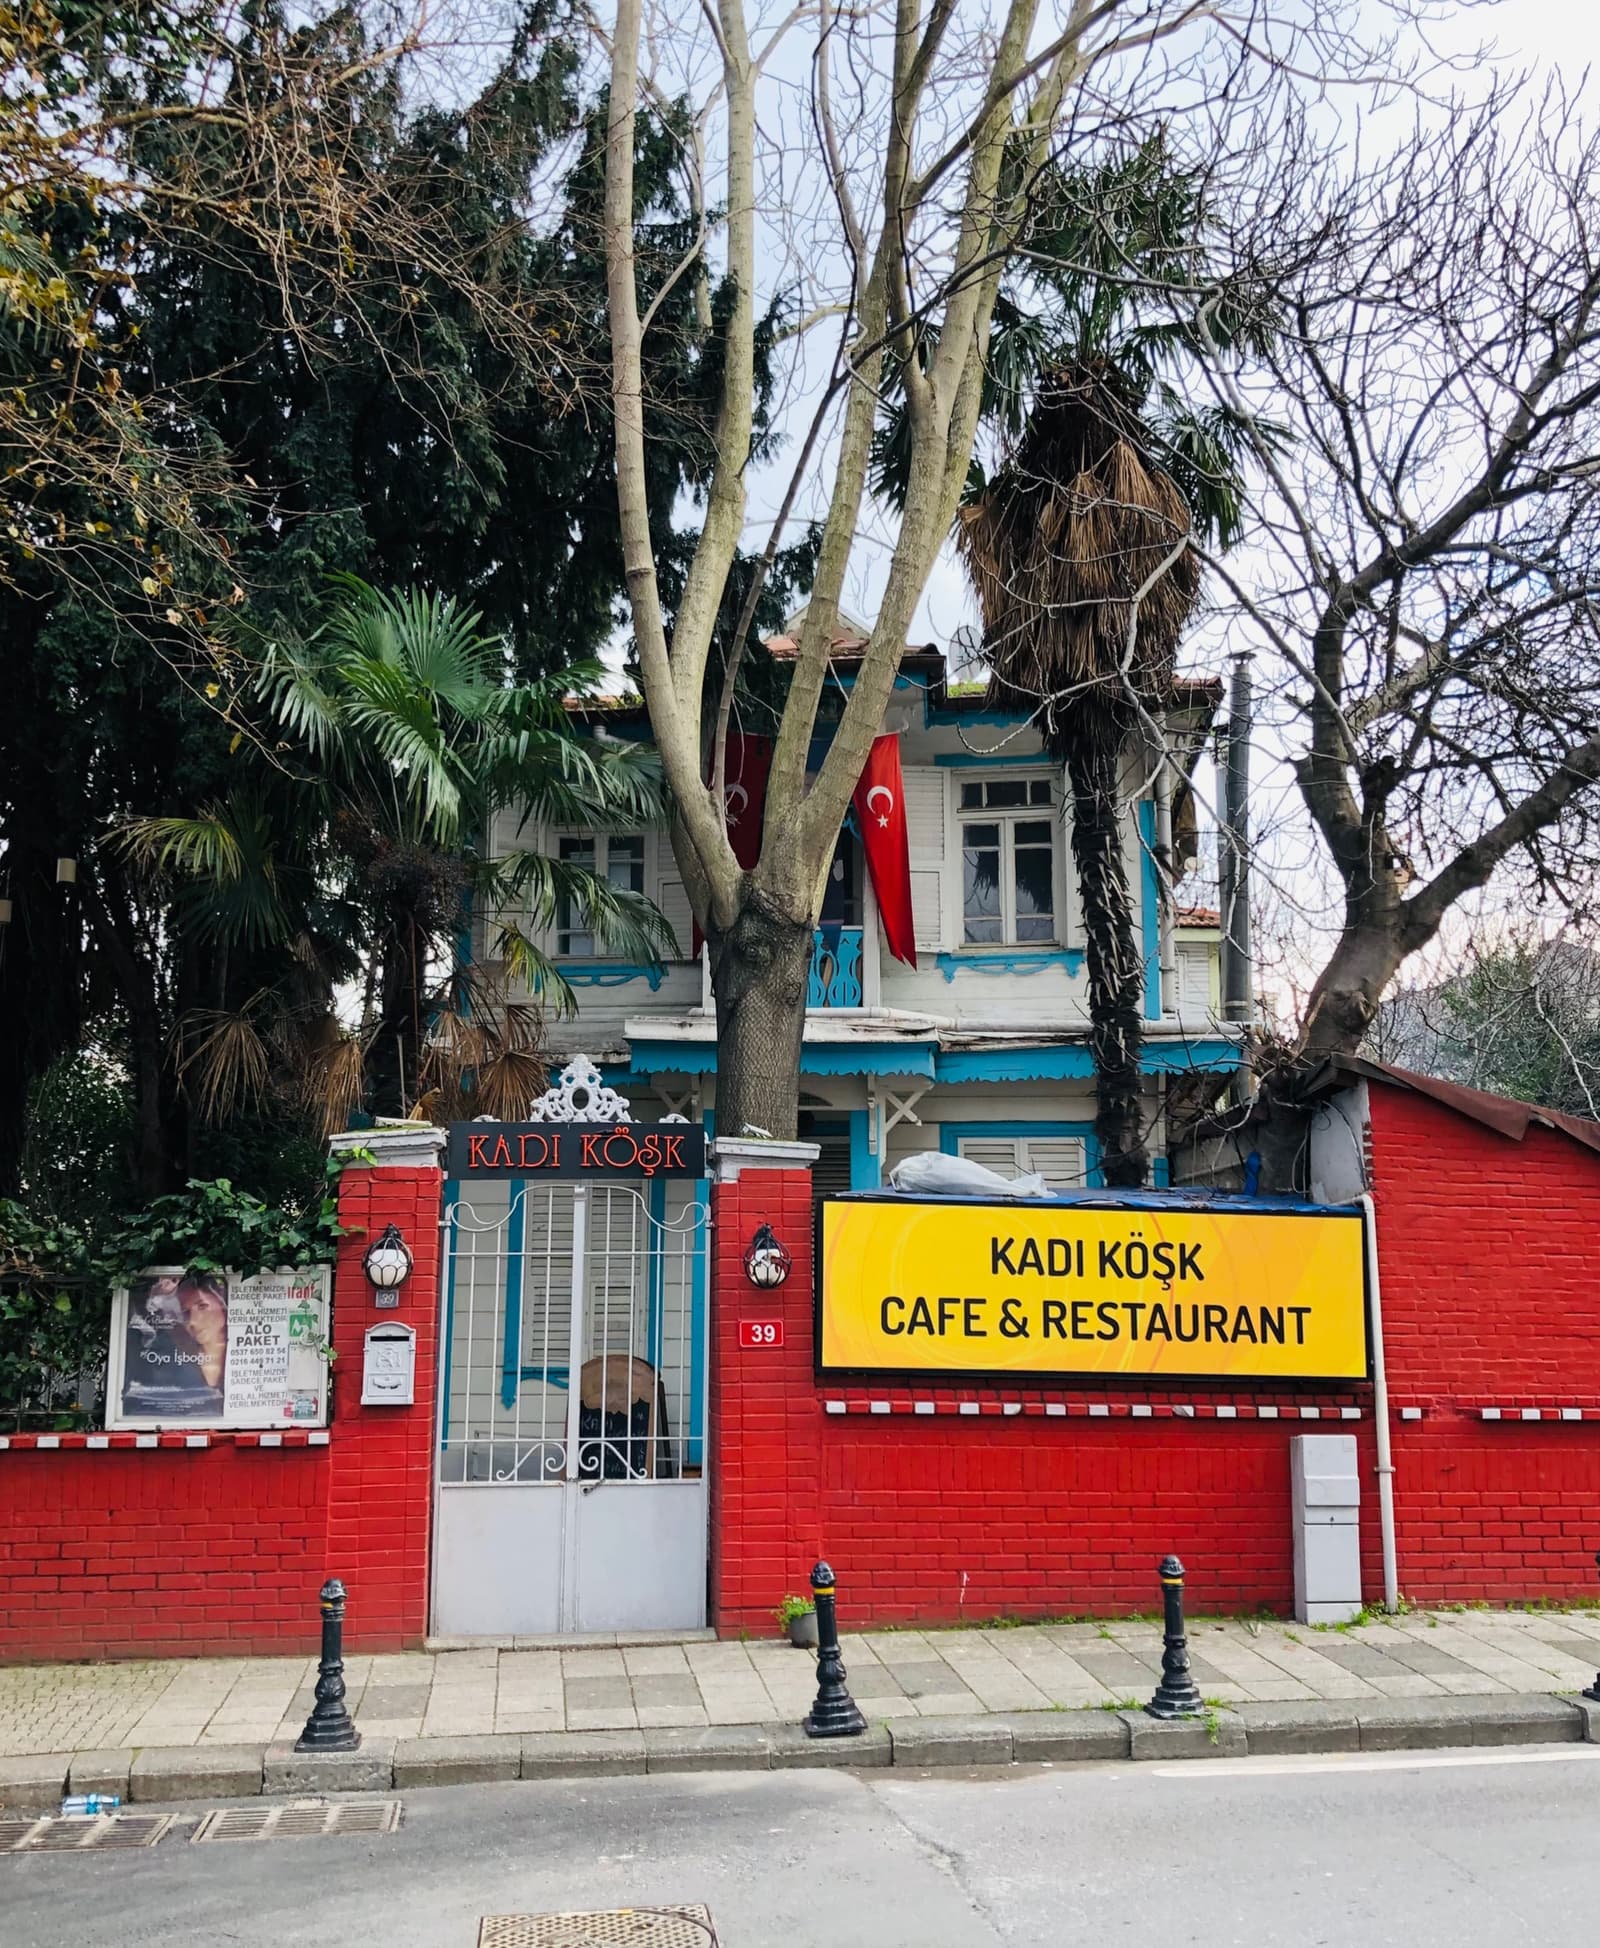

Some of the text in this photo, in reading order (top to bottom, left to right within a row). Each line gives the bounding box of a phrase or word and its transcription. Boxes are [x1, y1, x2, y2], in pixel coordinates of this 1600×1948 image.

[468, 1126, 687, 1176] KADI KÖŞK
[990, 1231, 1205, 1291] KADI KÖŞK
[230, 1292, 287, 1301] SADECE PAKET
[229, 1308, 244, 1316] GEL
[880, 1296, 1312, 1345] CAFE & RESTAURANT
[245, 1324, 272, 1335] ALO
[751, 1324, 776, 1343] 39
[236, 1335, 280, 1347] PAKET
[230, 1348, 249, 1356] 0537
[265, 1347, 275, 1355] 82
[146, 1351, 170, 1365] Oya
[230, 1358, 249, 1366] 0216
[276, 1356, 286, 1364] 21
[230, 1376, 288, 1385] SADECE PAKET
[253, 1384, 264, 1392] VE
[229, 1393, 245, 1401] GEL
[246, 1392, 256, 1400] AL
